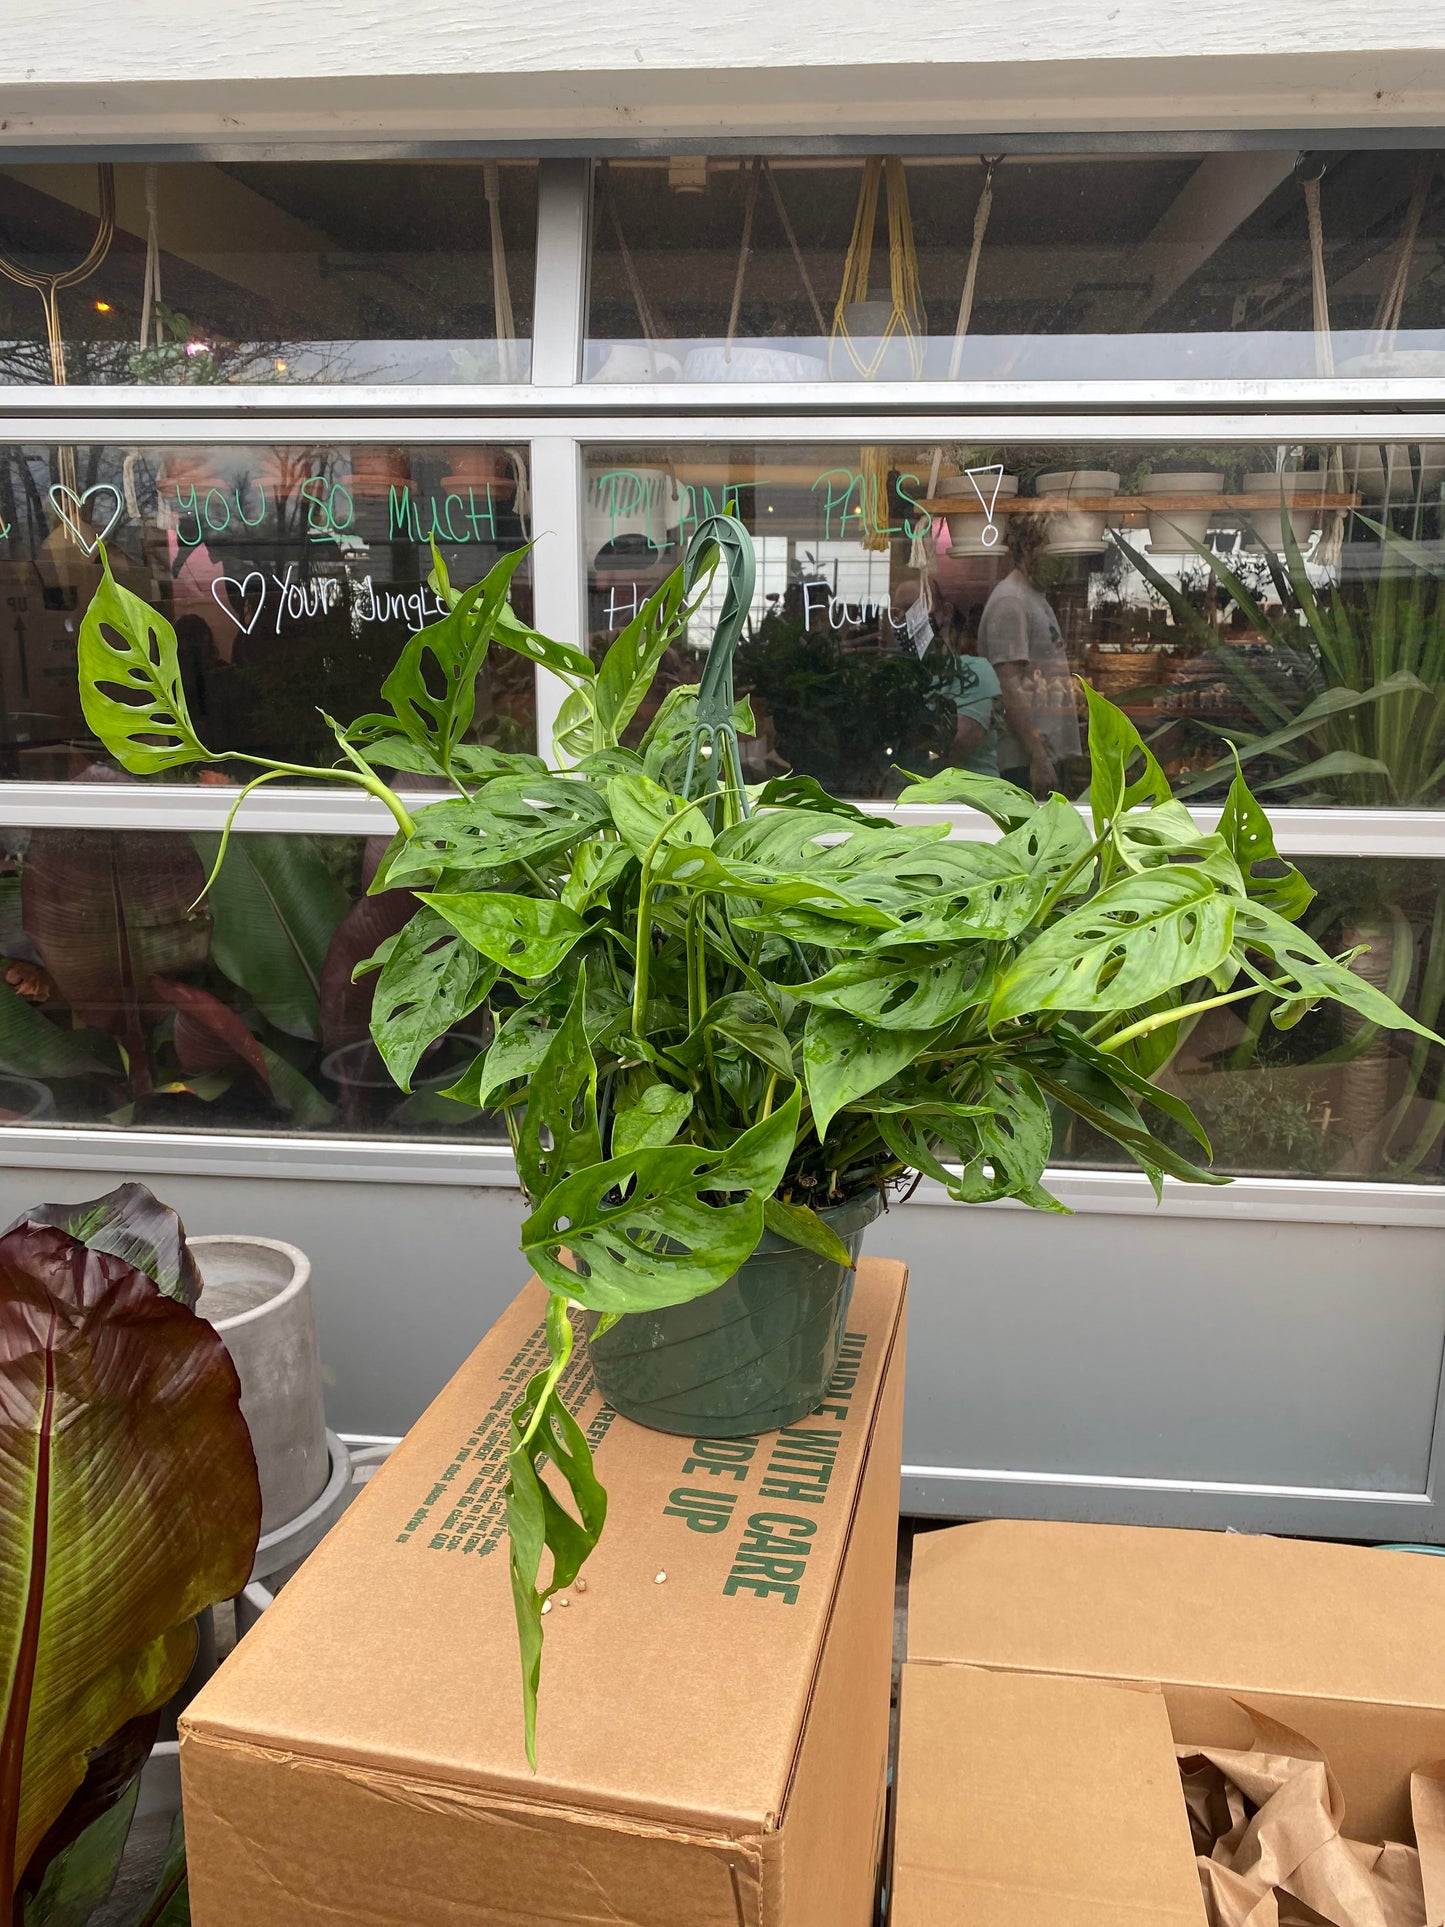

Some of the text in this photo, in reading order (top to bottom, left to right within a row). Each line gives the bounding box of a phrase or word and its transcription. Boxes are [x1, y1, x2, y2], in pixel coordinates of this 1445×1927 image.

[176, 483, 266, 546] YOU
[301, 476, 355, 533] SO
[389, 482, 496, 543] MUCH
[599, 471, 771, 550] PLANT
[811, 467, 932, 541] PALS
[272, 565, 338, 635] Your
[478, 1464, 497, 1477] YOU
[486, 1502, 502, 1515] call
[662, 1487, 738, 1534] UP
[722, 1428, 842, 1606] WITH CARE
[430, 1534, 449, 1550] OUR
